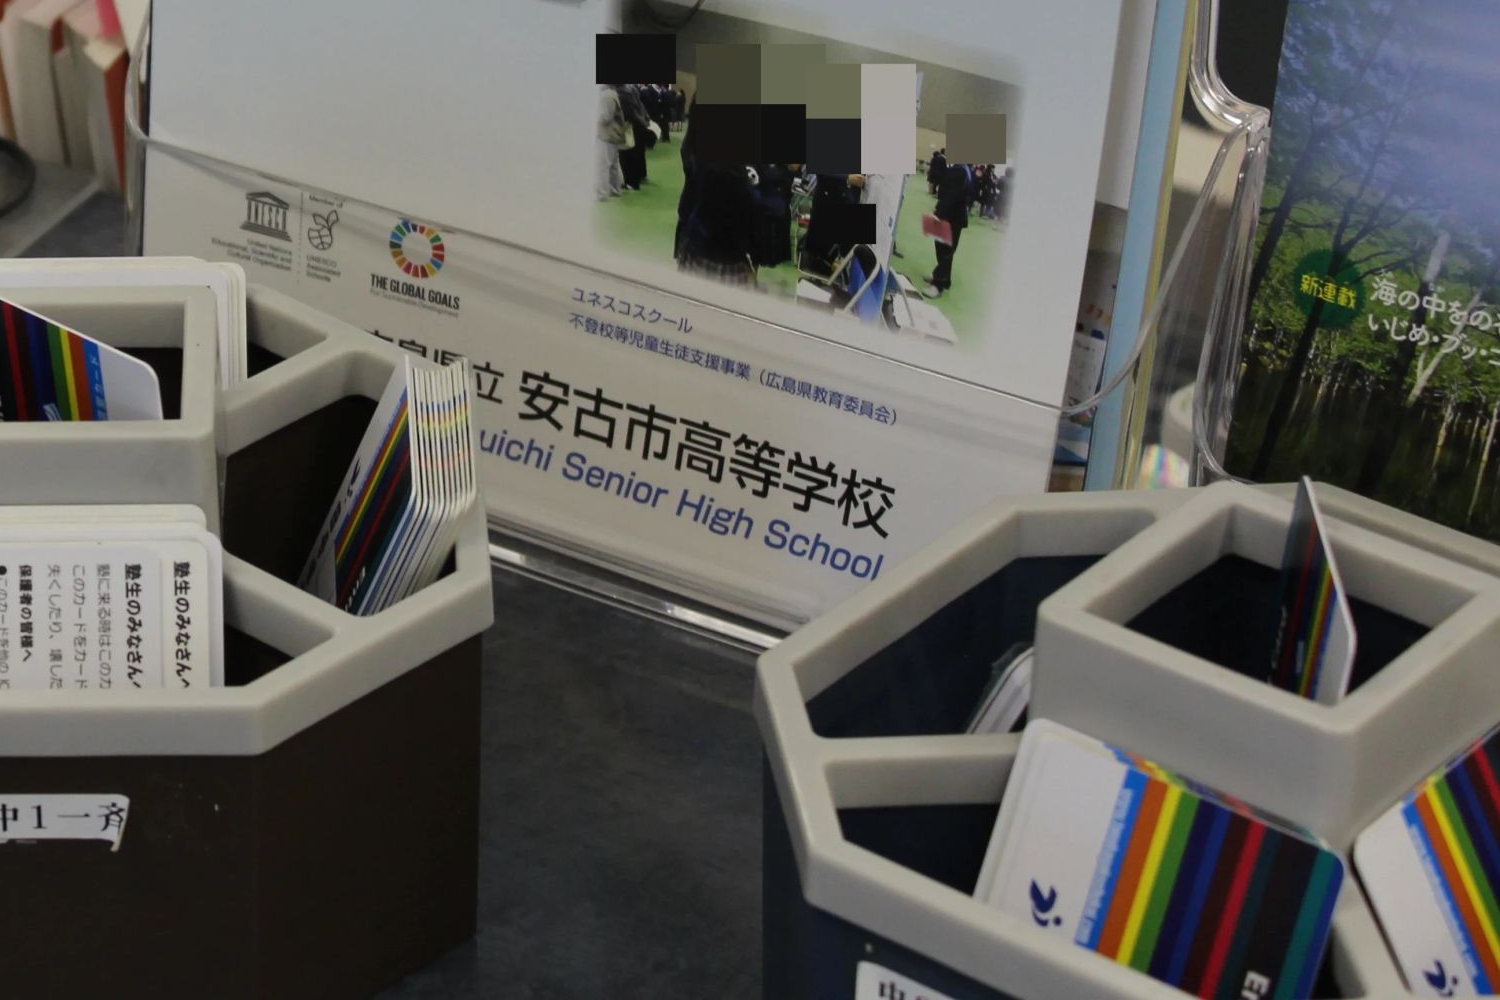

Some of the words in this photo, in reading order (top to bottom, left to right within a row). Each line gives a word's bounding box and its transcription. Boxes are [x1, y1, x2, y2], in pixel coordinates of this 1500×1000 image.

[370, 273, 389, 290] THE
[389, 279, 426, 302] GLOBAL
[428, 290, 461, 311] GOALS
[572, 287, 694, 334] ユネスコスクール
[1300, 273, 1358, 310] 新連載
[518, 369, 897, 539] 安古市高等学校
[562, 451, 670, 509] Senior
[675, 488, 754, 540] High
[763, 518, 885, 582] School
[19, 564, 34, 663] 保護者の皆様へ
